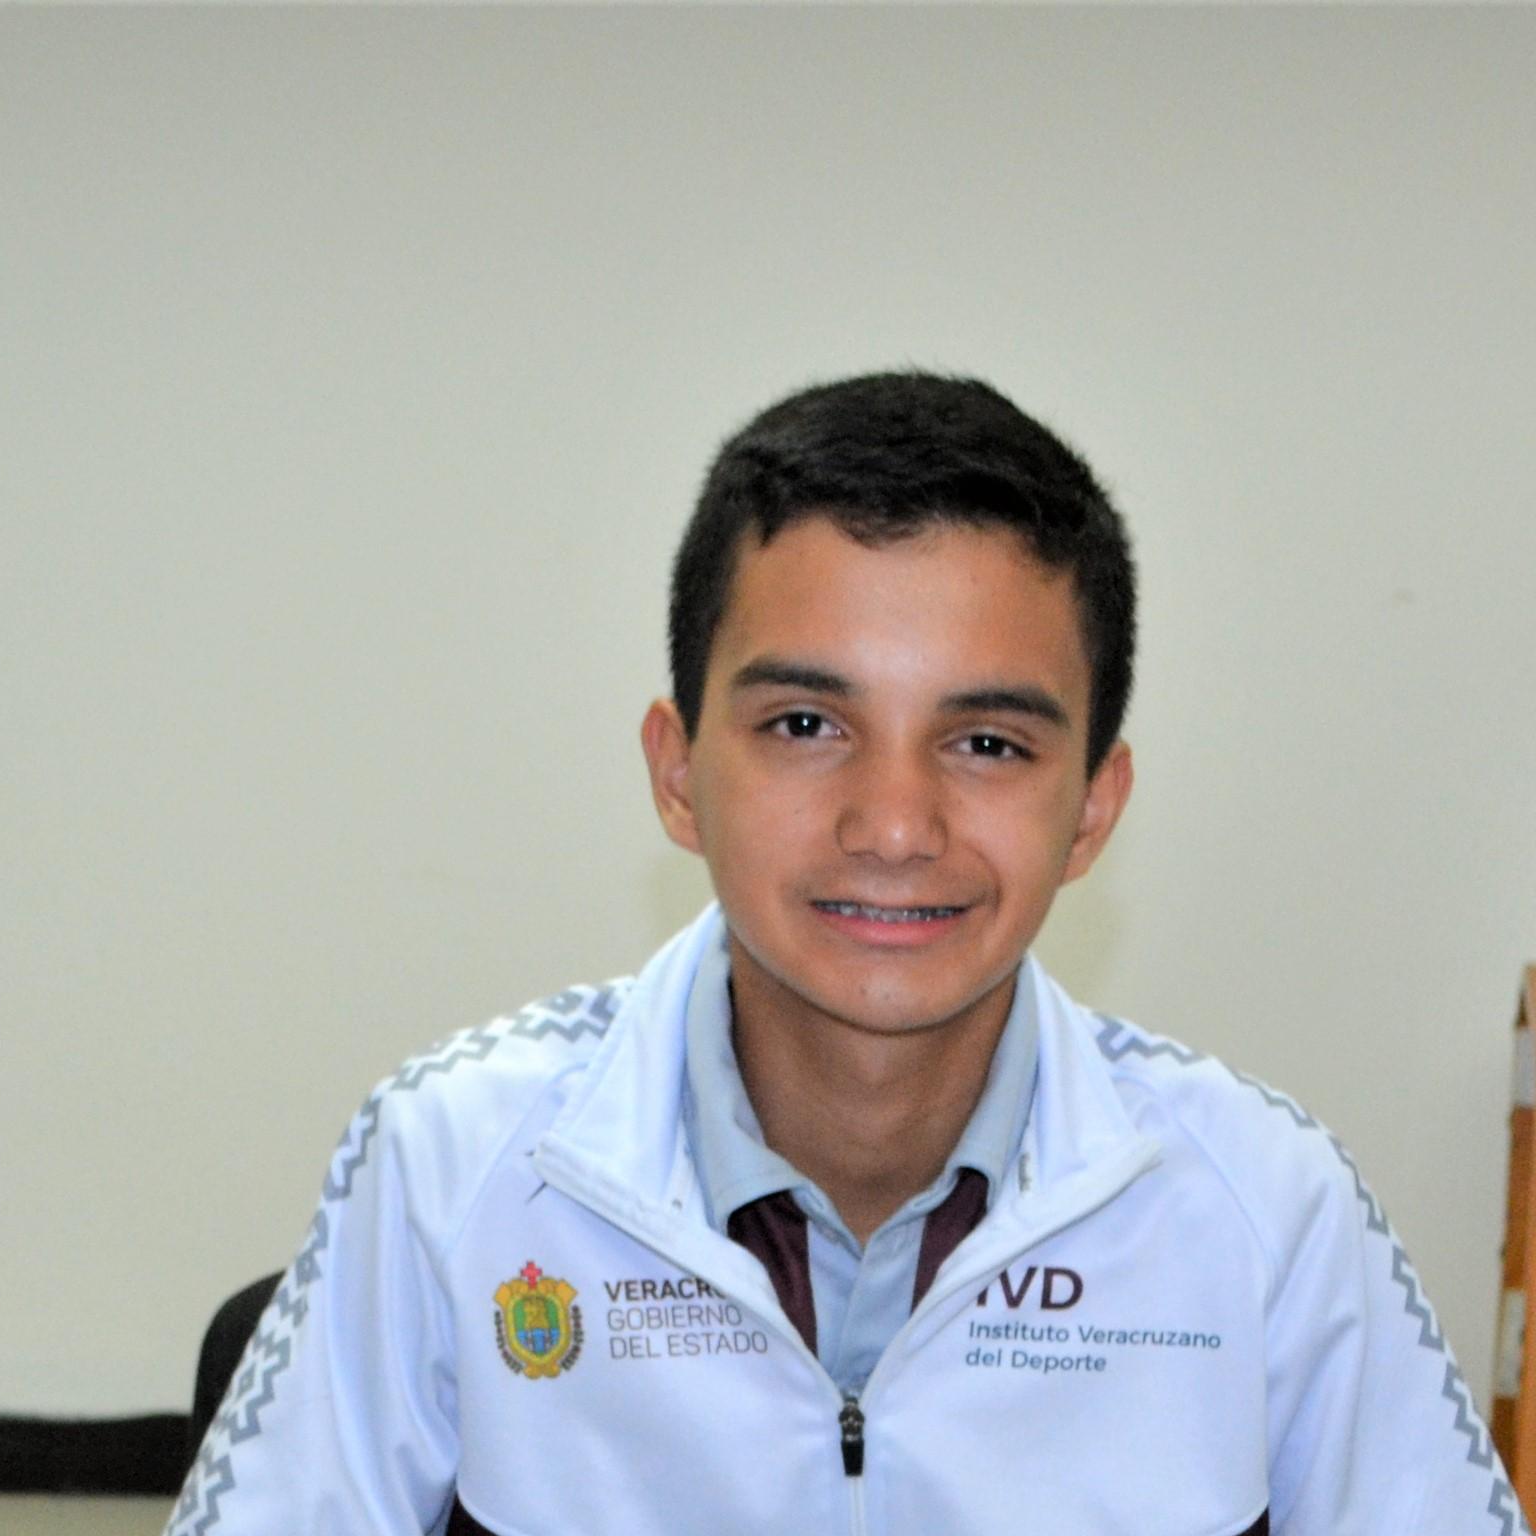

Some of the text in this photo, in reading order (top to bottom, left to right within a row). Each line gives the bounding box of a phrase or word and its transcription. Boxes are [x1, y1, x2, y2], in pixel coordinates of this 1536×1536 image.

[607, 1304, 743, 1332] GOBIERNO
[609, 1330, 769, 1360] DEL ESTADO
[968, 1321, 1222, 1350] Instituto Veracruzano
[965, 1348, 1107, 1374] del Deporte
